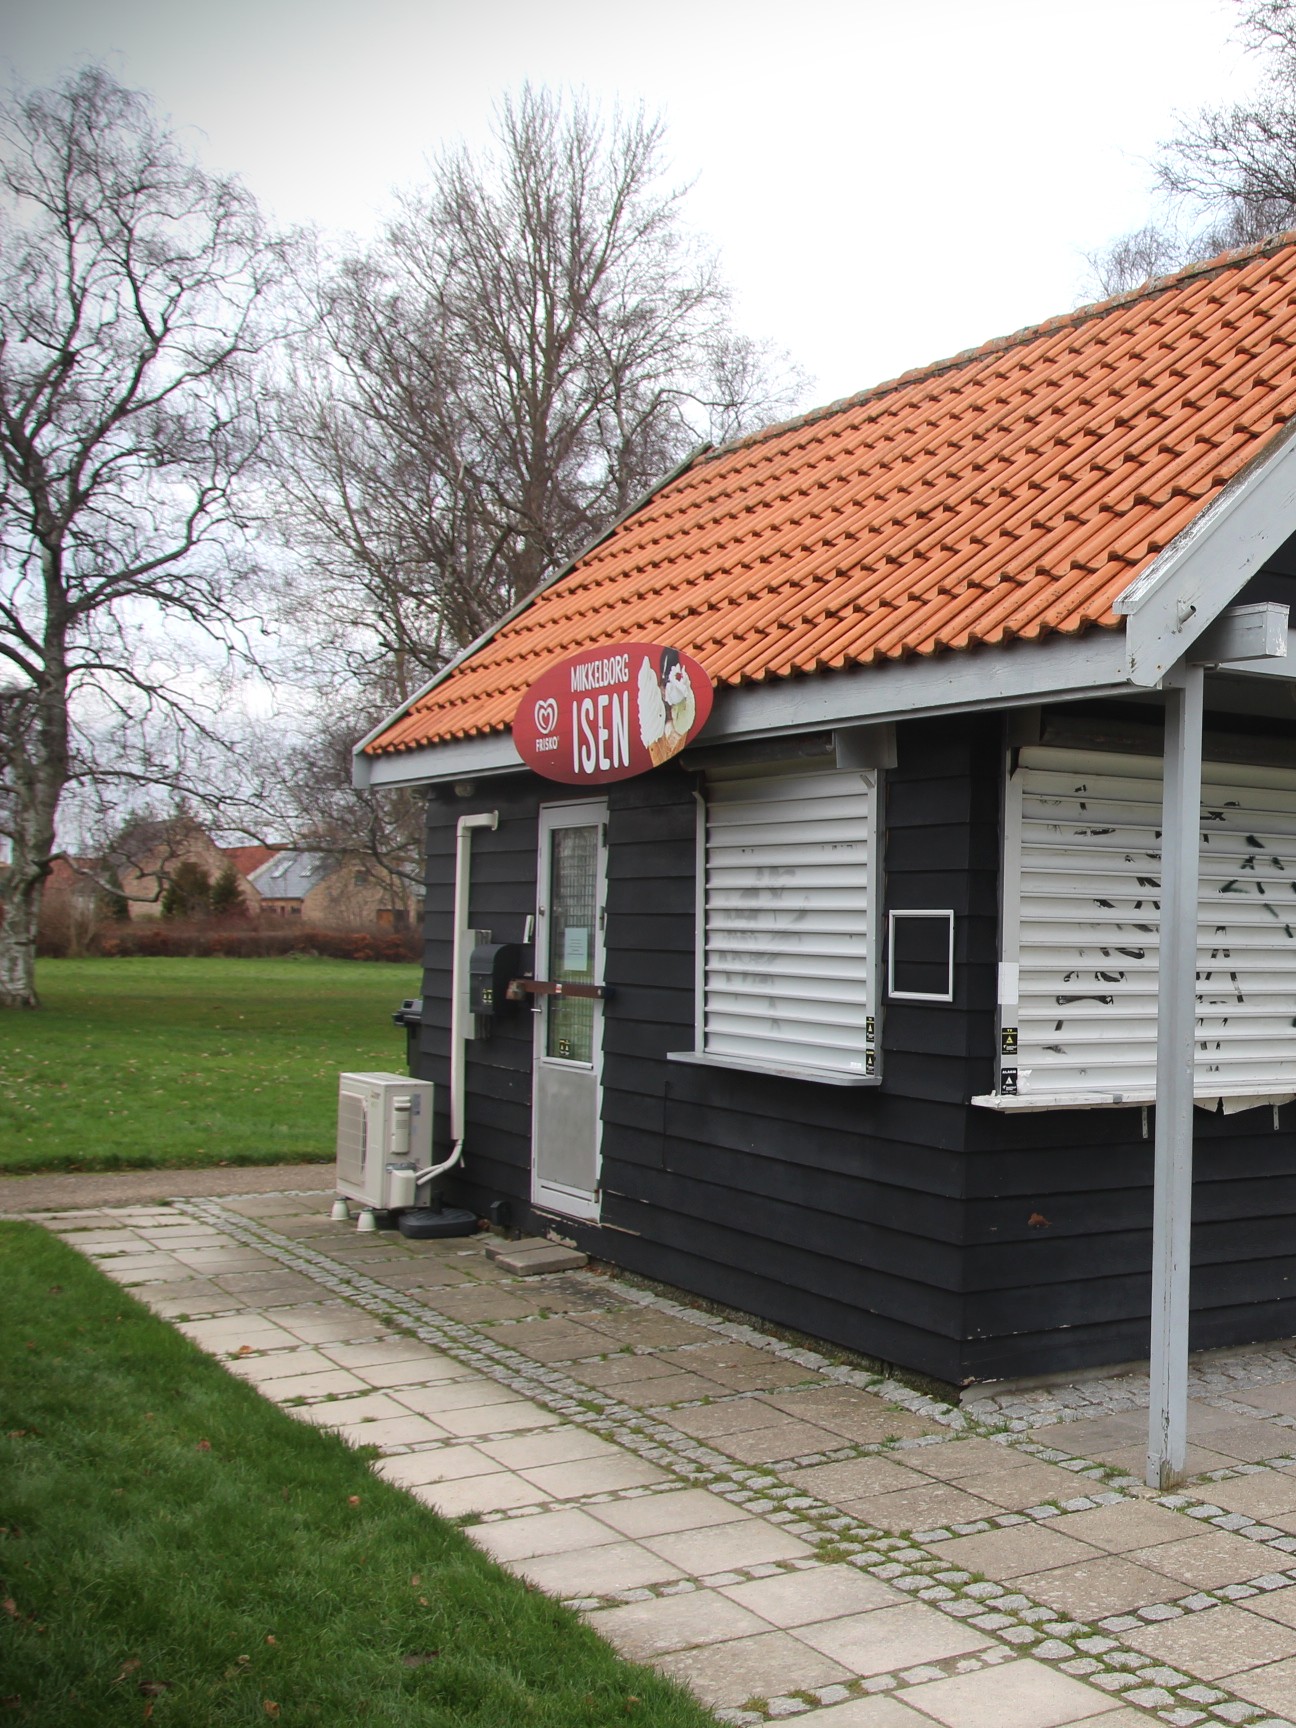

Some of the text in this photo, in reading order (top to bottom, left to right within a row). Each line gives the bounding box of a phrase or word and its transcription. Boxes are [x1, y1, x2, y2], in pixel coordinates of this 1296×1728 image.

[571, 654, 629, 692] MIKKELBORG
[535, 736, 558, 752] FRISKO
[572, 690, 630, 774] ISEN
